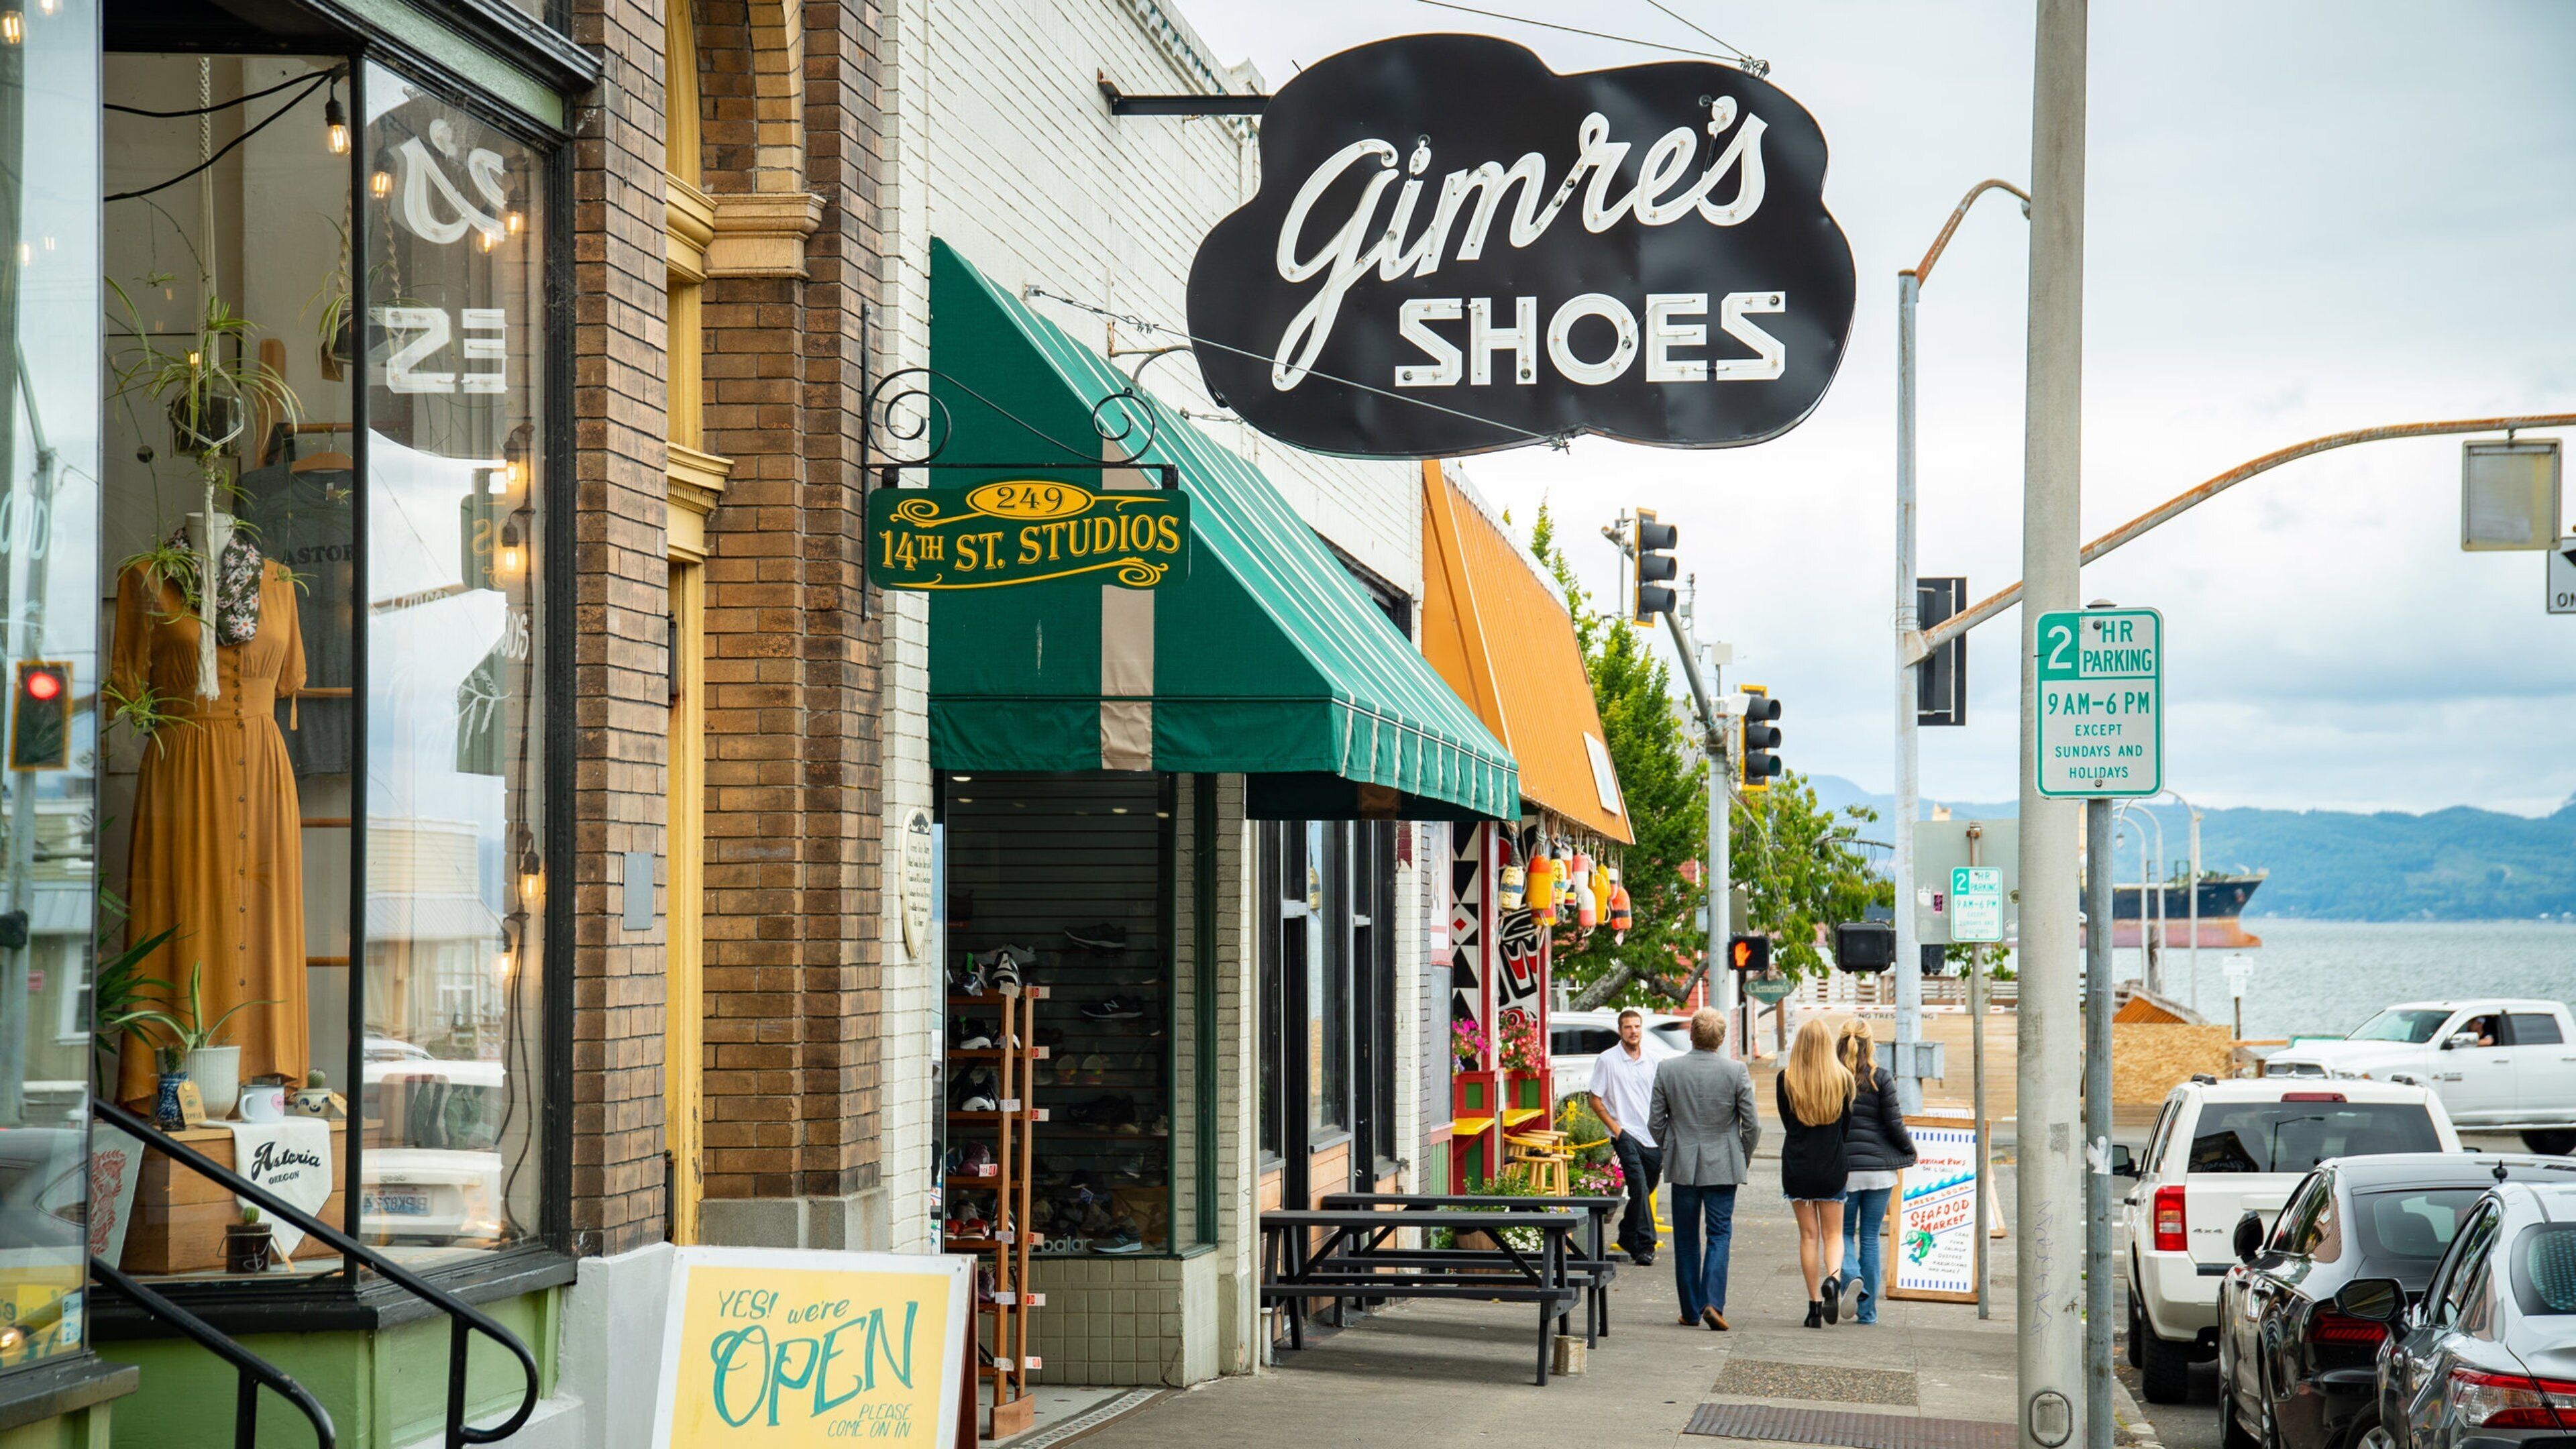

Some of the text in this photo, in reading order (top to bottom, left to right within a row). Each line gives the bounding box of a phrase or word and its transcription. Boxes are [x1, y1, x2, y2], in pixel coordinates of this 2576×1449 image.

[1395, 292, 1786, 386] SHOES
[996, 486, 1064, 511] 249
[879, 515, 1181, 571] 14TH ST. STUDIOS
[282, 545, 353, 565] ASTOR
[2047, 621, 2133, 669] 2 HR
[2083, 649, 2152, 672] PARKING
[2075, 724, 2123, 737] EXCEPT
[2055, 745, 2143, 758] SUNDAYS AND
[2070, 766, 2129, 779] HOLIDAYS
[1955, 873, 1967, 892] 2
[251, 1141, 321, 1181] Astoria
[268, 1171, 300, 1185] OREGON
[1908, 1185, 1970, 1208] FRESH LOCAL
[1910, 1199, 1970, 1228] SEAFOOD
[1919, 1214, 1966, 1233] MARKET
[718, 1289, 850, 1324] YES! we're
[710, 1301, 918, 1428] OPEN
[859, 1403, 912, 1421] PLEASE
[827, 1420, 912, 1438] COME ON IN
